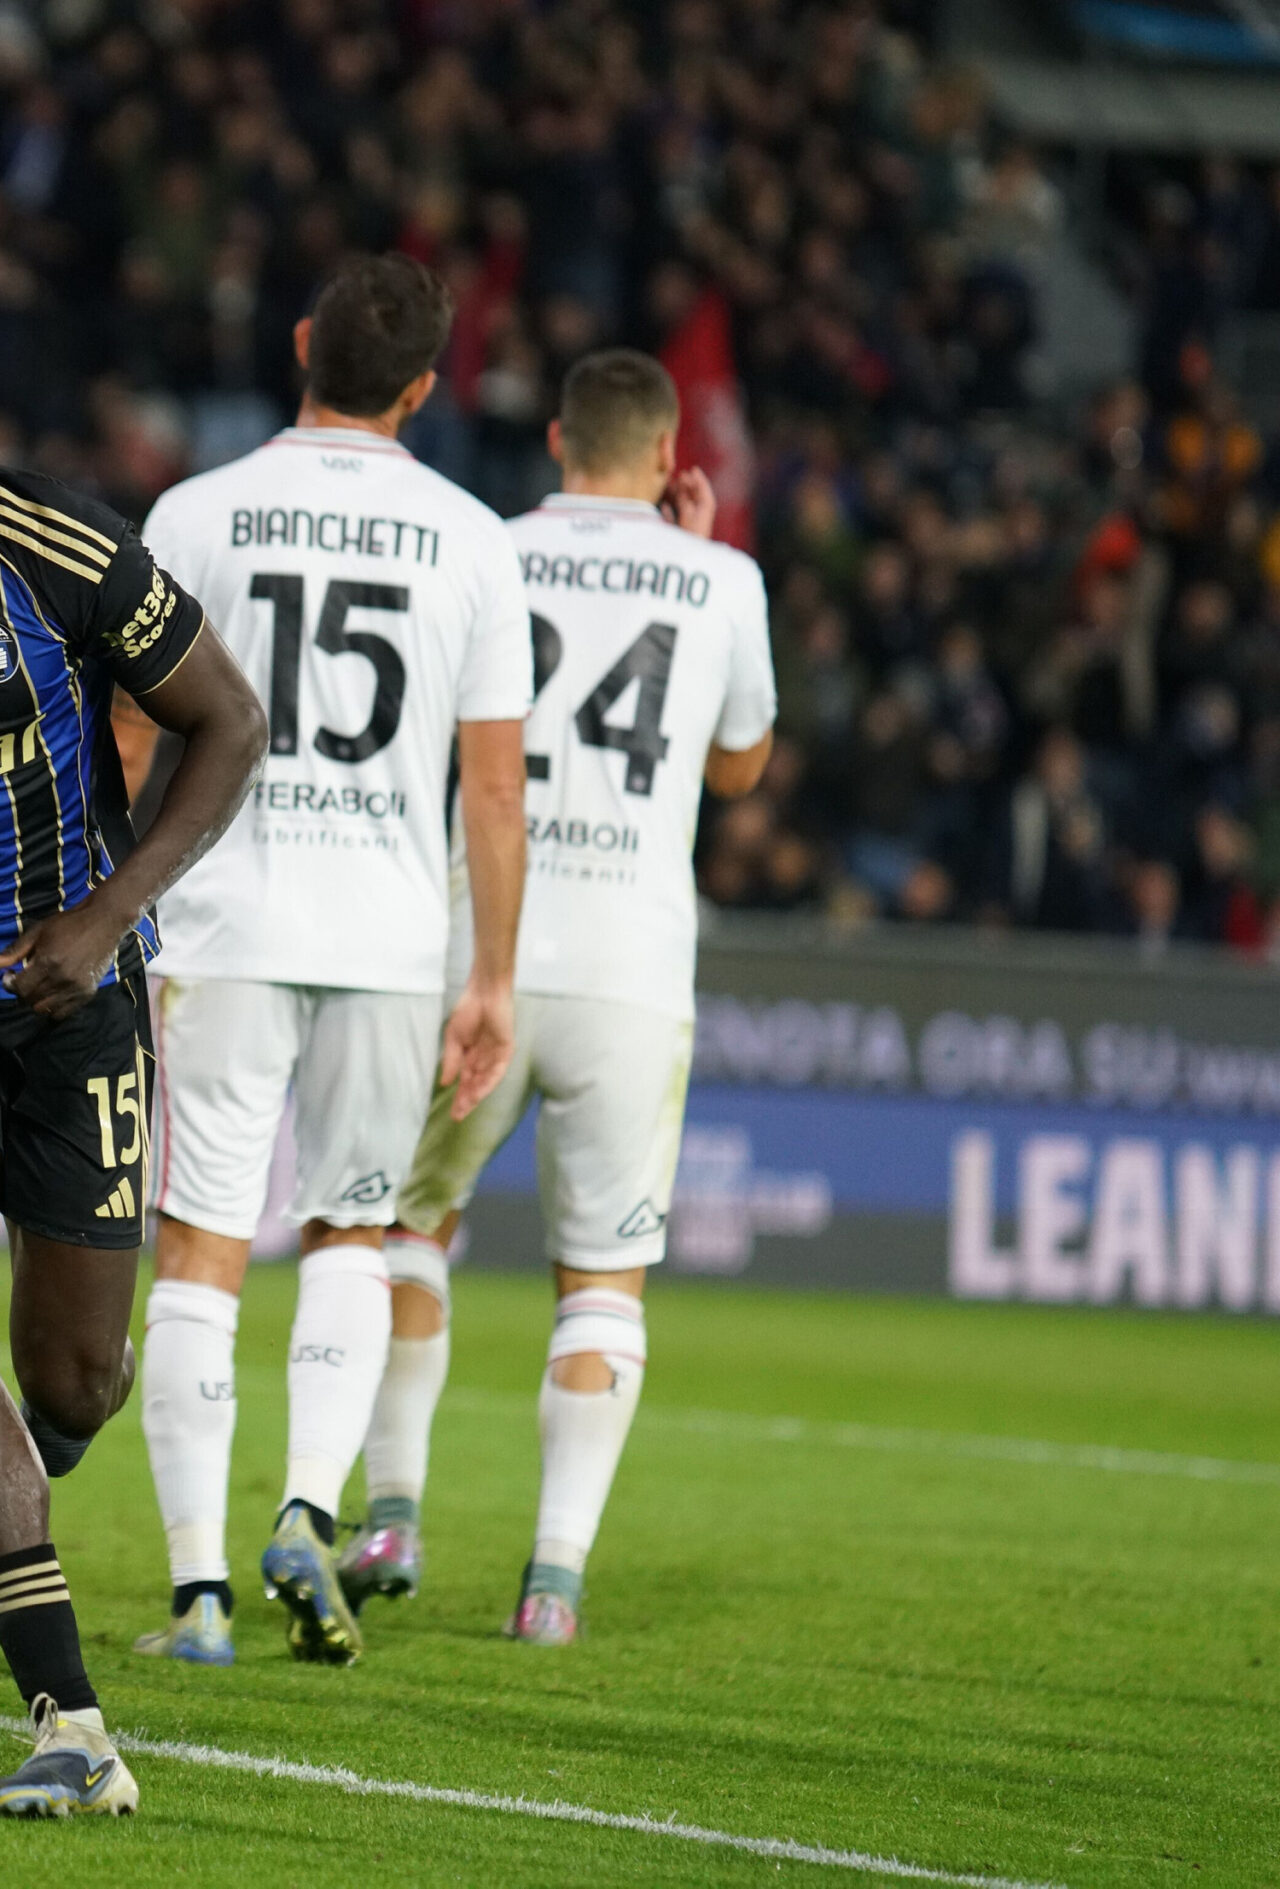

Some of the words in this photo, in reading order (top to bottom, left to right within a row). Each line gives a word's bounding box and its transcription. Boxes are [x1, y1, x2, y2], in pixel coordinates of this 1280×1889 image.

[231, 508, 439, 567] BIANCHETTI
[521, 551, 710, 608] RACCIANO
[249, 572, 410, 766] 15
[87, 1071, 141, 1169] 15
[199, 1380, 236, 1402] US
